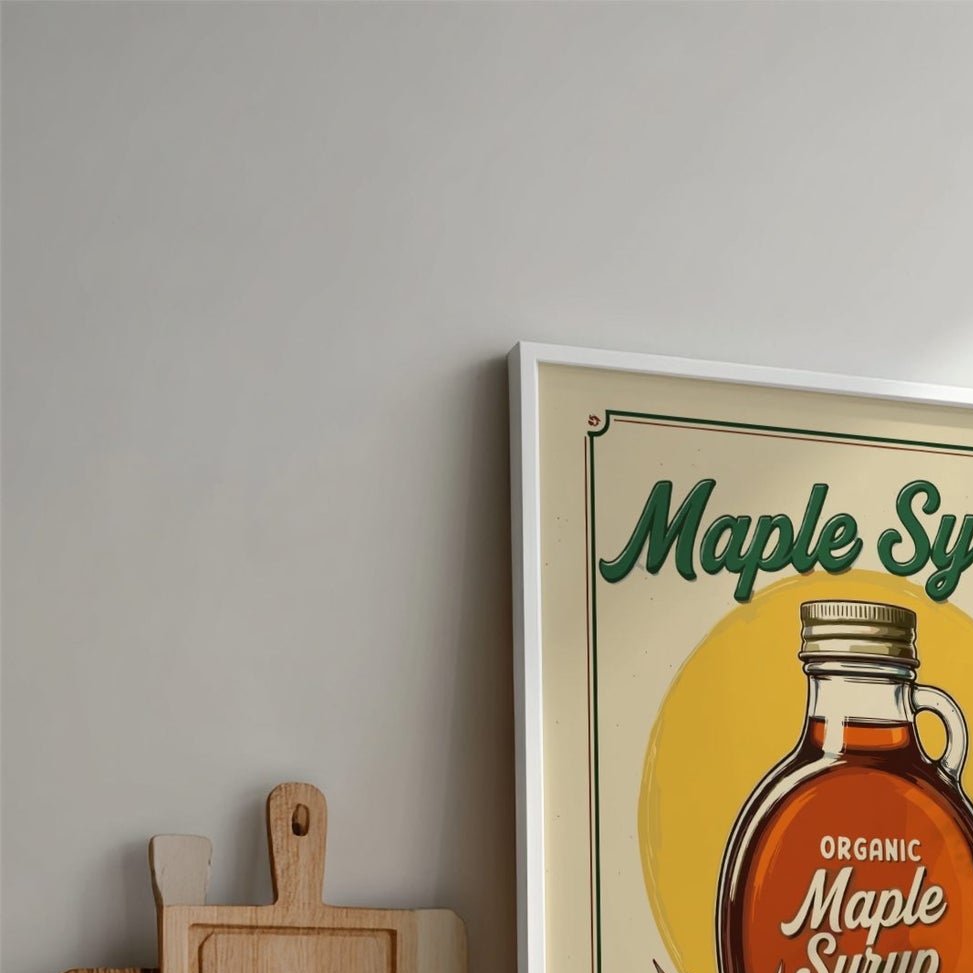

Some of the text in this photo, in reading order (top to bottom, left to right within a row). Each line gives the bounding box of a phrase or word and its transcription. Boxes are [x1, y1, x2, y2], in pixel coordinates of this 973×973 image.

[599, 479, 864, 603] Maple
[820, 835, 922, 862] ORGANIC
[780, 866, 947, 946] Maple
